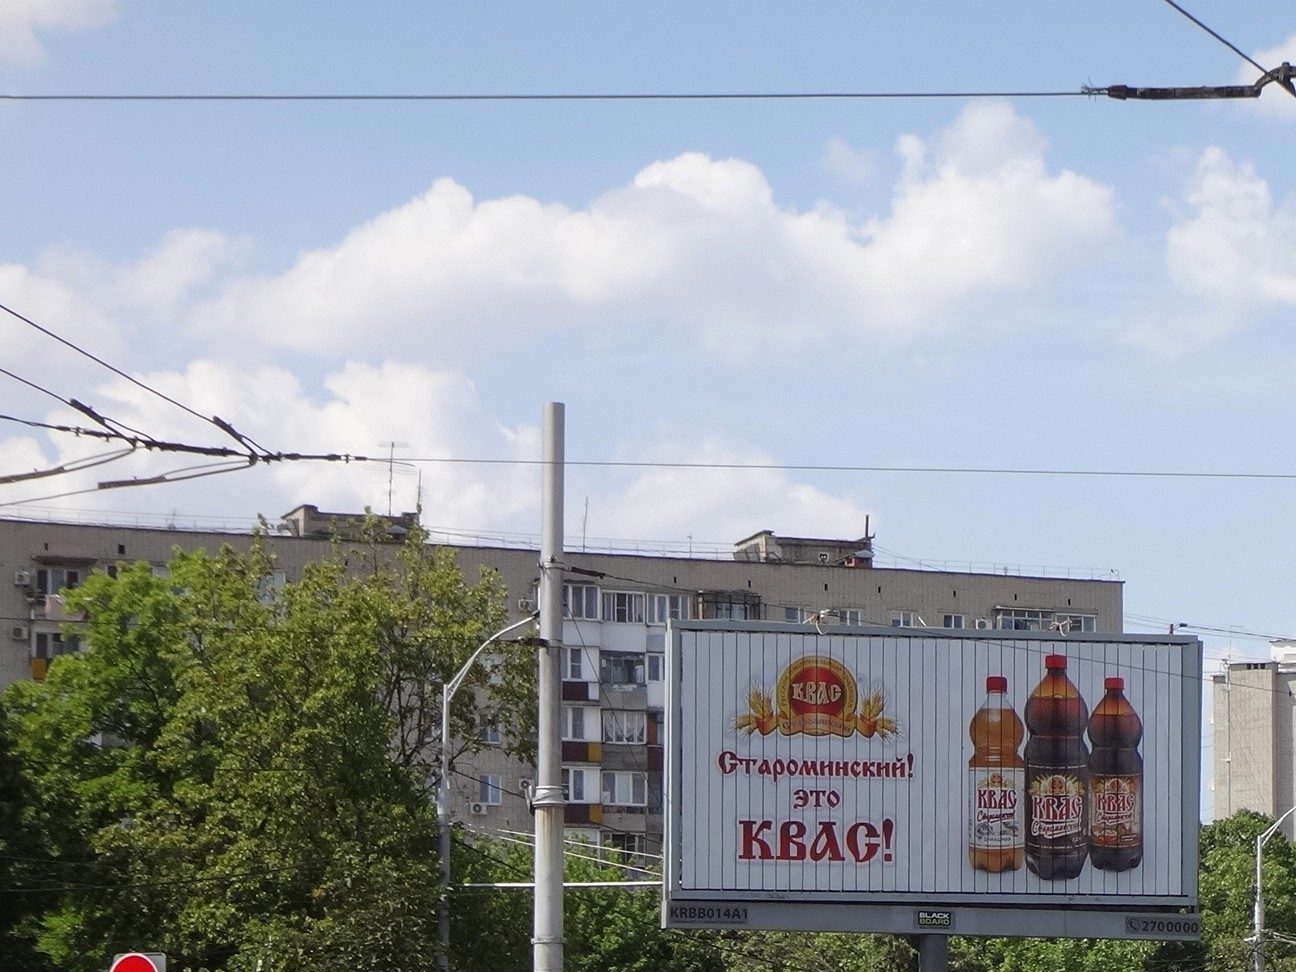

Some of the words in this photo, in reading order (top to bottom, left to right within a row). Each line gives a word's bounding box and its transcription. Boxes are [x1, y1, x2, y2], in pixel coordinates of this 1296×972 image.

[792, 681, 842, 706] КВАС
[718, 751, 914, 782] Староминский!
[793, 789, 841, 809] это
[977, 789, 1018, 809] КВАС
[1032, 795, 1082, 820] КВАС
[1096, 793, 1135, 812] КВАС
[738, 818, 894, 862] КВАС!
[670, 907, 748, 919] KRBB014A1
[1142, 921, 1198, 932] 2700000
